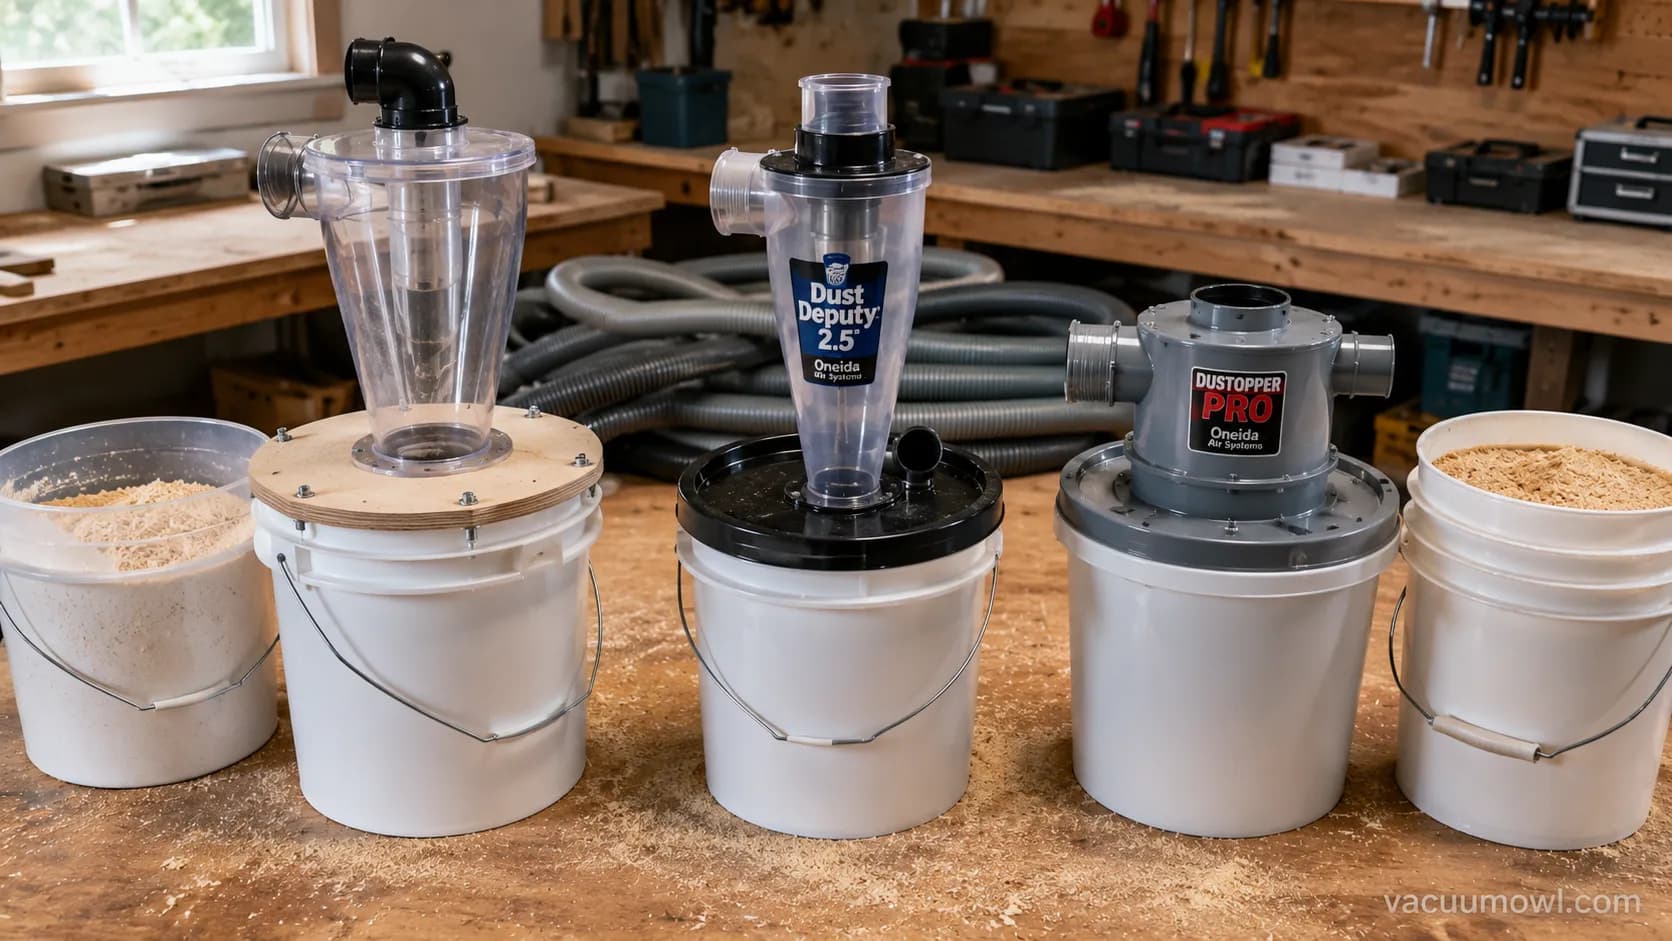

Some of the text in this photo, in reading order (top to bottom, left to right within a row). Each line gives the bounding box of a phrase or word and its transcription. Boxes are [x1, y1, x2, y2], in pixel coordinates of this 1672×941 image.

[810, 282, 864, 305] Dust
[814, 359, 860, 373] Oneida
[1196, 372, 1282, 392] DUSTOPPER
[1202, 391, 1273, 423] PRO
[1210, 426, 1259, 441] Oneida
[1207, 438, 1222, 448] Air
